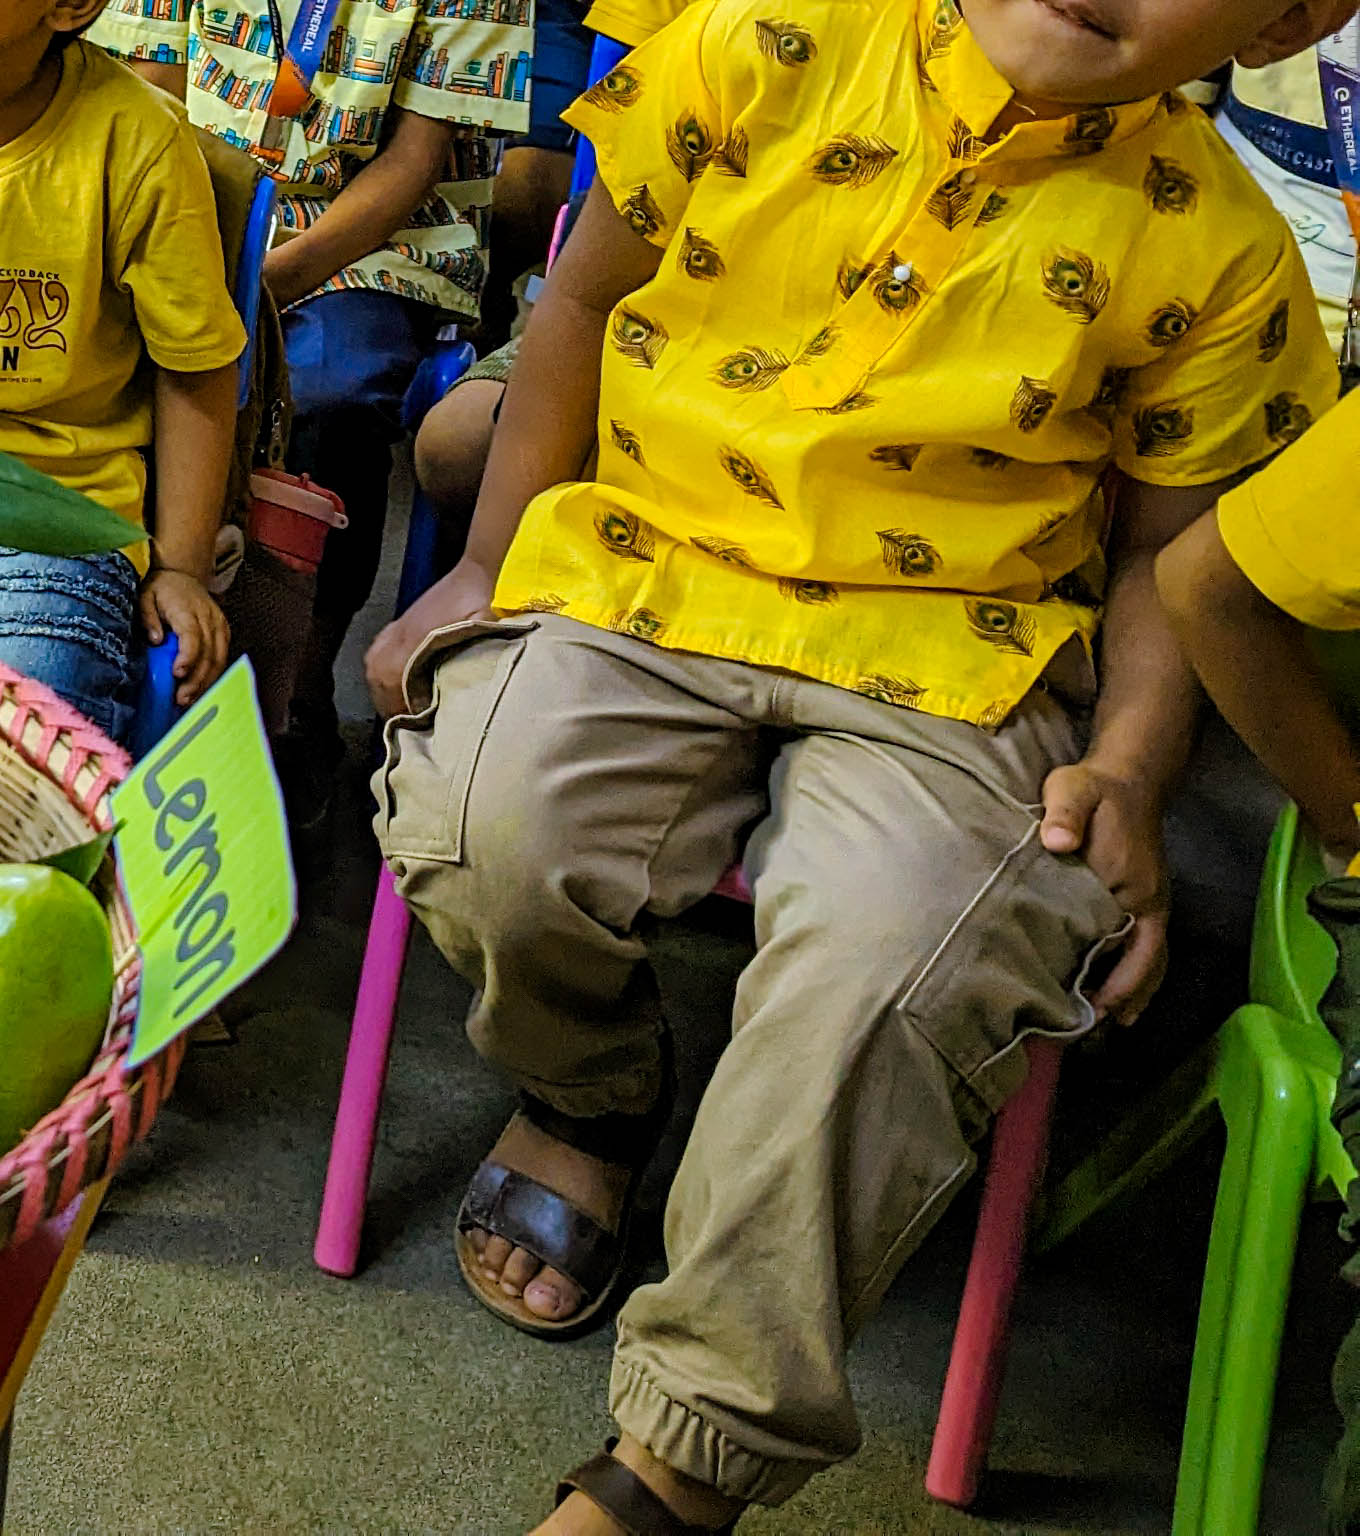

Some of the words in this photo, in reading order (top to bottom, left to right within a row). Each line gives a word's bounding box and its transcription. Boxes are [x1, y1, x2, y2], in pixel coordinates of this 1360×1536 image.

[1340, 105, 1360, 176] ETHEREAL
[14, 268, 27, 278] TO
[28, 269, 61, 281] BACK
[142, 704, 237, 1020] Lemon
